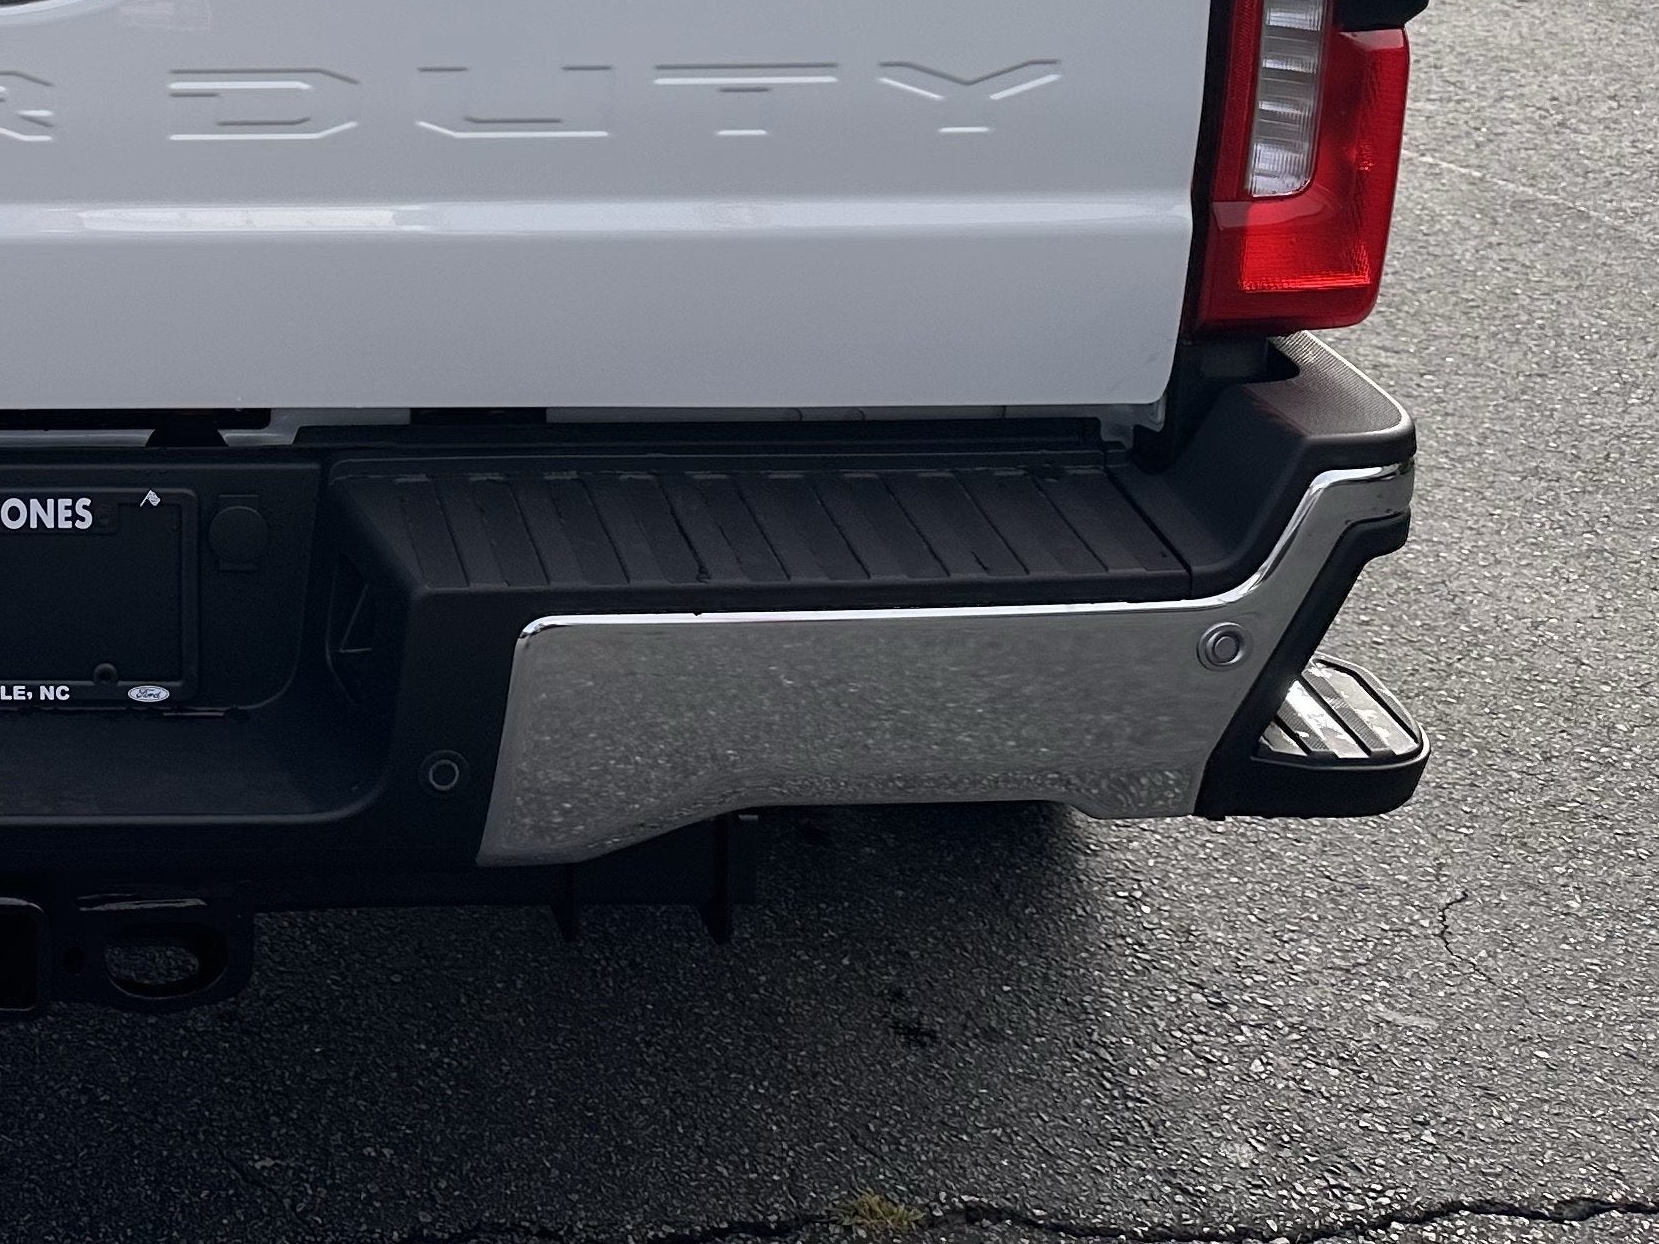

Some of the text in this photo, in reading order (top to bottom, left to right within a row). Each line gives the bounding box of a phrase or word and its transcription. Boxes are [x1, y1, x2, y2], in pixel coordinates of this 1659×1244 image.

[167, 59, 1062, 141] DUTY
[39, 685, 71, 701] NC
[135, 687, 163, 700] Ford
